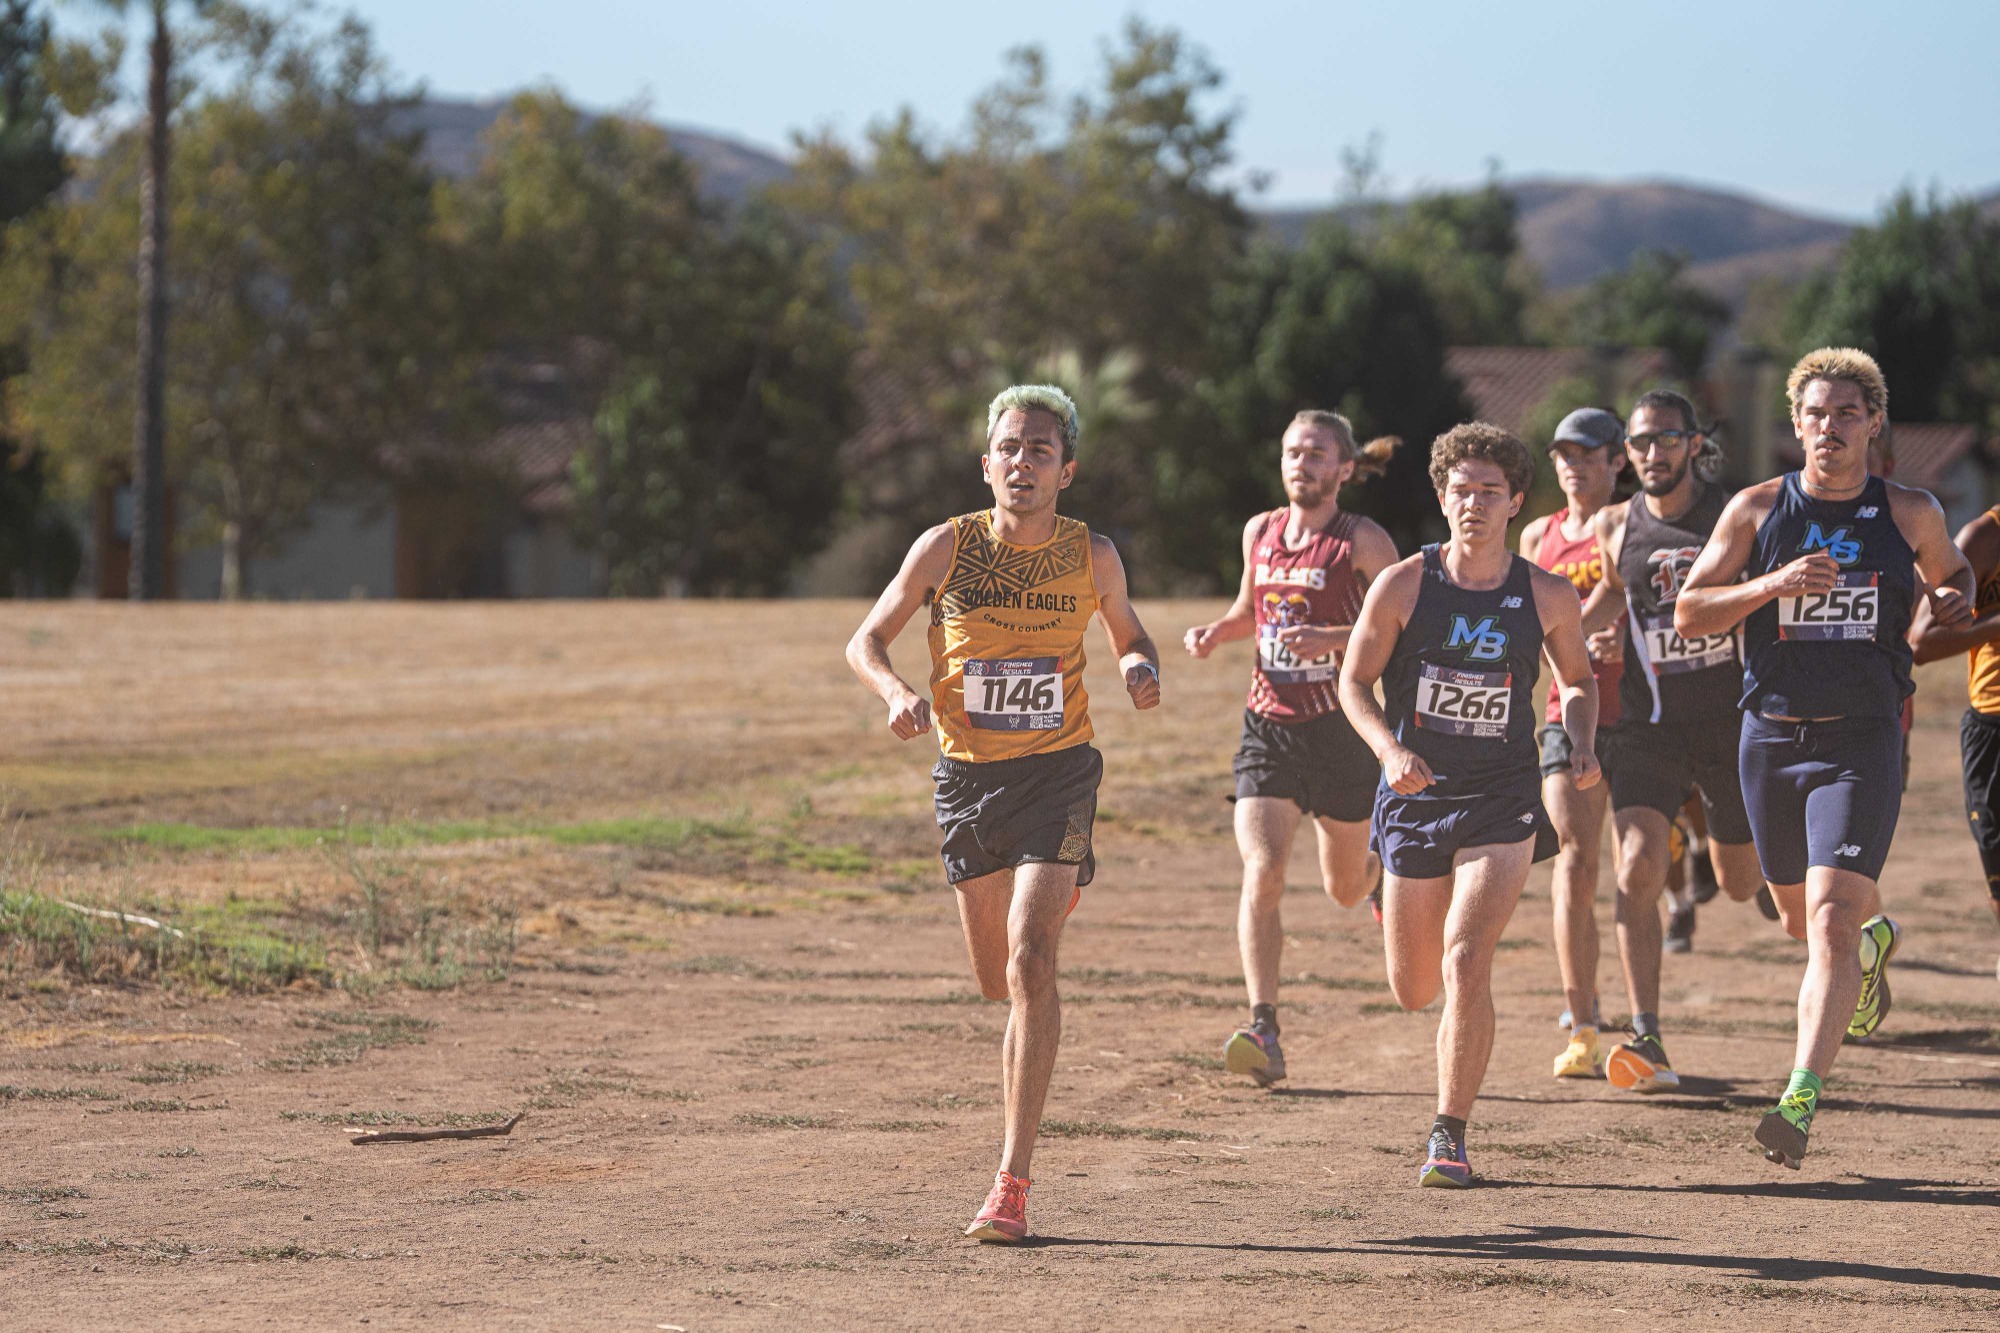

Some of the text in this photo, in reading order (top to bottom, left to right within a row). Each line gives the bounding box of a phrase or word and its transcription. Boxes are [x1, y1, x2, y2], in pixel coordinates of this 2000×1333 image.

[1797, 521, 1864, 567] MB
[1255, 564, 1326, 590] RAMS
[964, 590, 1077, 613] GOLDEN EAGLES
[1793, 590, 1875, 622] 1256
[983, 613, 1062, 633] CROSS COUNTRY
[1442, 614, 1509, 662] MB
[1003, 661, 1033, 669] FINISHED
[1456, 672, 1485, 680] FINISHED
[982, 676, 1055, 712] 1146
[1428, 682, 1508, 721] 1266
